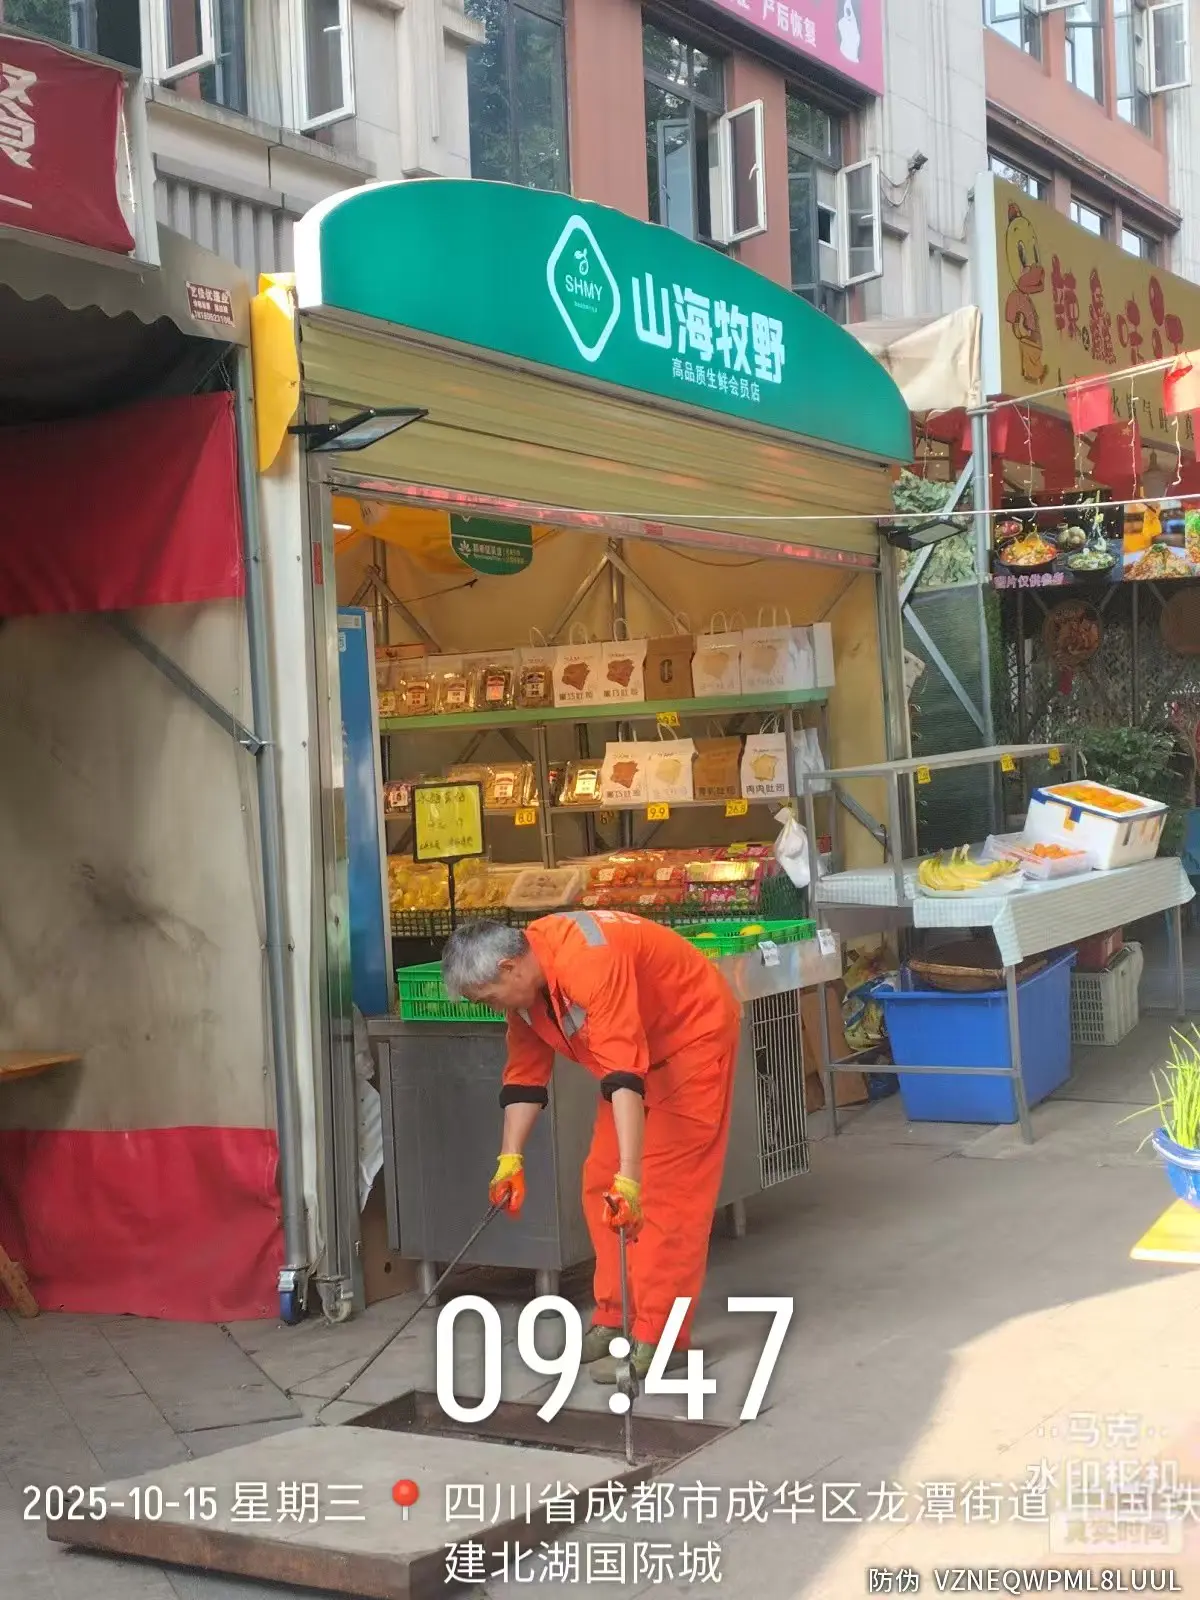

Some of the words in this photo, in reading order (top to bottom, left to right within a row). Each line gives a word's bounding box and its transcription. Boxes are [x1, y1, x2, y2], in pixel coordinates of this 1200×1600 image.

[565, 274, 603, 301] SHMY
[631, 272, 785, 384] 山海牧野
[671, 357, 761, 402] 高品质生鲜会员店
[650, 806, 666, 819] 9.9
